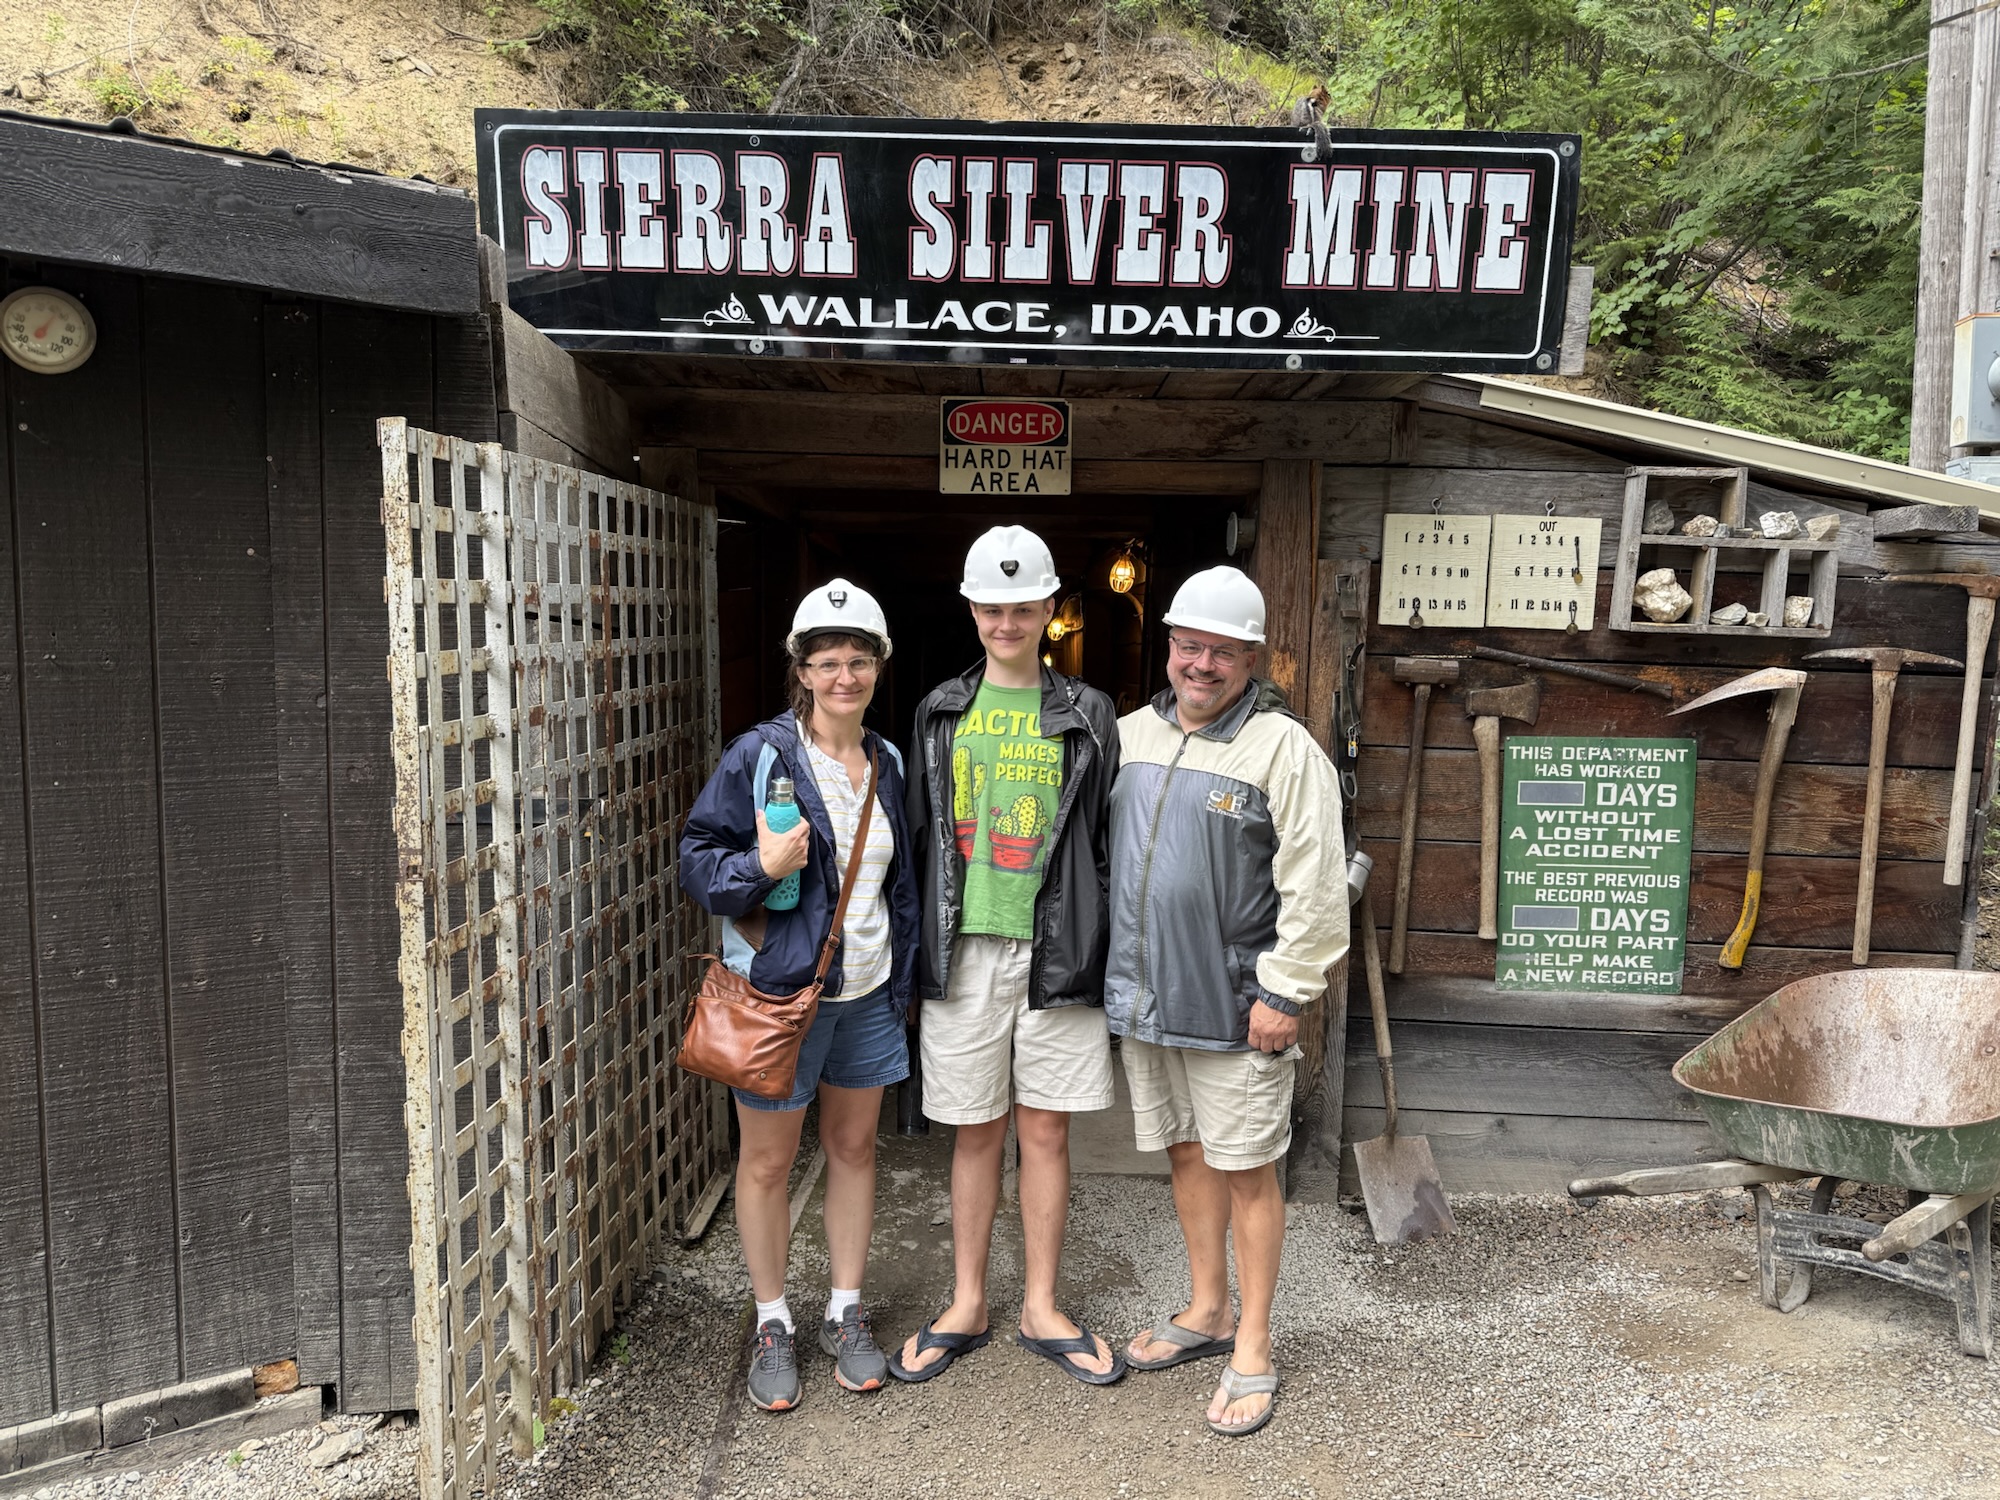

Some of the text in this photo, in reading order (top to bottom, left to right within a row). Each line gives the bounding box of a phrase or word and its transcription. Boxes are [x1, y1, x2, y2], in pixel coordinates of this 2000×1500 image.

[521, 144, 1535, 294] SIERRA SILVER MINE
[758, 294, 1281, 338] WALLACE, IDAHO
[50, 342, 64, 354] 120
[60, 335, 73, 346] 100
[955, 412, 1057, 435] DANGER
[945, 448, 1066, 470] HARD HAT
[970, 472, 1040, 493] AREA
[1434, 520, 1444, 530] IN
[1539, 521, 1557, 532] OUT
[1405, 532, 1469, 545] 1 2 3 4 5
[1518, 534, 1522, 544] 1
[1531, 535, 1536, 545] 2
[1546, 536, 1551, 545] 3
[1558, 536, 1563, 546] 4
[1402, 564, 1469, 578] 6 7 8 9 10
[1515, 566, 1520, 576] 6
[1529, 566, 1534, 576] 7
[1544, 567, 1549, 577] 8
[1558, 567, 1563, 577] 9
[1399, 598, 1405, 608] 11
[1429, 599, 1437, 610] 13
[1444, 600, 1452, 610] 14
[1458, 600, 1466, 610] 15
[1511, 599, 1518, 609] 11
[1526, 600, 1534, 610] 12
[1541, 600, 1550, 610] 13
[1554, 600, 1562, 611] 14
[954, 709, 1064, 741] ACTU
[1000, 742, 1059, 764] MAKES
[1509, 746, 1688, 762] THIS DEPARTMENT
[1535, 764, 1661, 778] HAS WORKED
[1596, 782, 1677, 807] DAYS
[1534, 810, 1656, 825] WITHOUT
[1509, 826, 1681, 843] A LOST TIME
[1525, 844, 1663, 859] ACCIDENT
[1504, 871, 1680, 888] THE BEST PREVIOUS
[1535, 889, 1648, 904] RECORD WAS
[1590, 908, 1670, 932] DAYS
[1502, 933, 1678, 950] DO YOUR PART
[1525, 953, 1654, 968] HELP MAKE
[1503, 969, 1674, 985] A NEW RECORD
